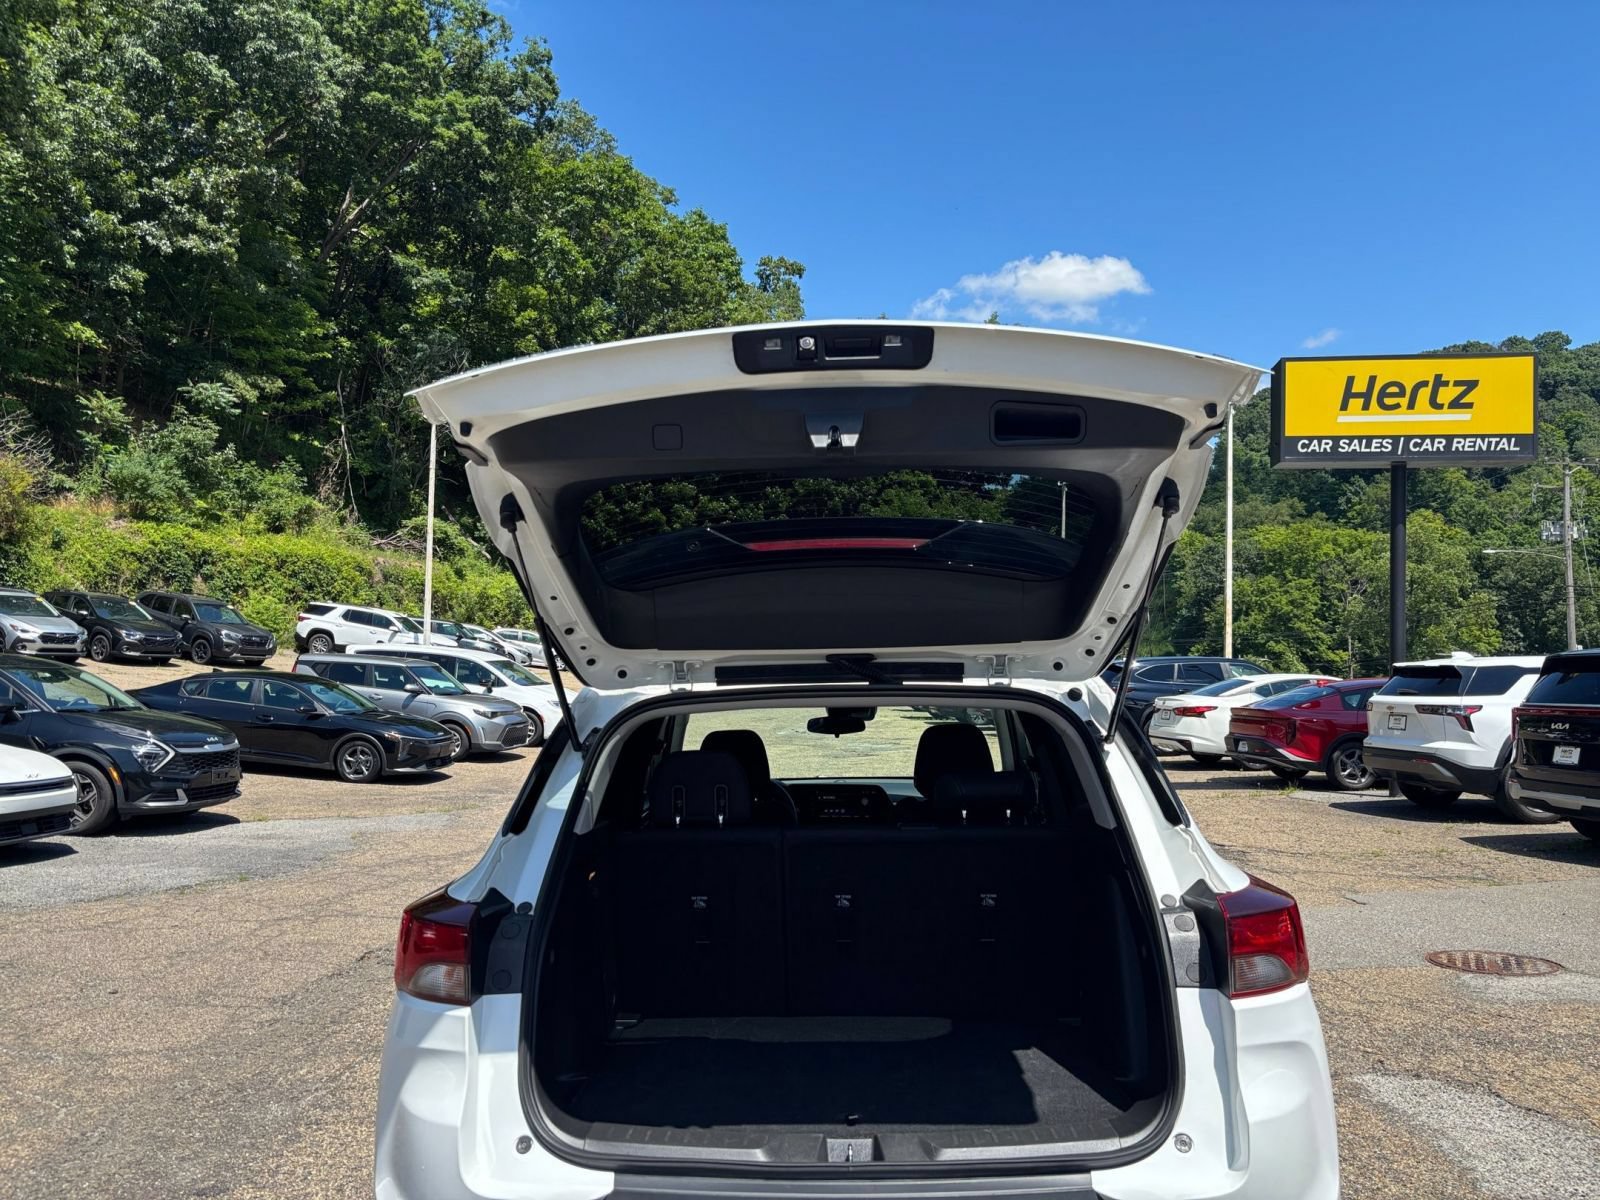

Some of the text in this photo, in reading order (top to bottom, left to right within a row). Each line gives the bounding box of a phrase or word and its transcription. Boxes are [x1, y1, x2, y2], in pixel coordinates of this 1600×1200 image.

[1340, 373, 1480, 411] Hertz
[1297, 439, 1333, 453] CAR
[1338, 438, 1393, 453] SALES
[1409, 438, 1446, 452] CAR
[1451, 437, 1520, 451] RENTAL
